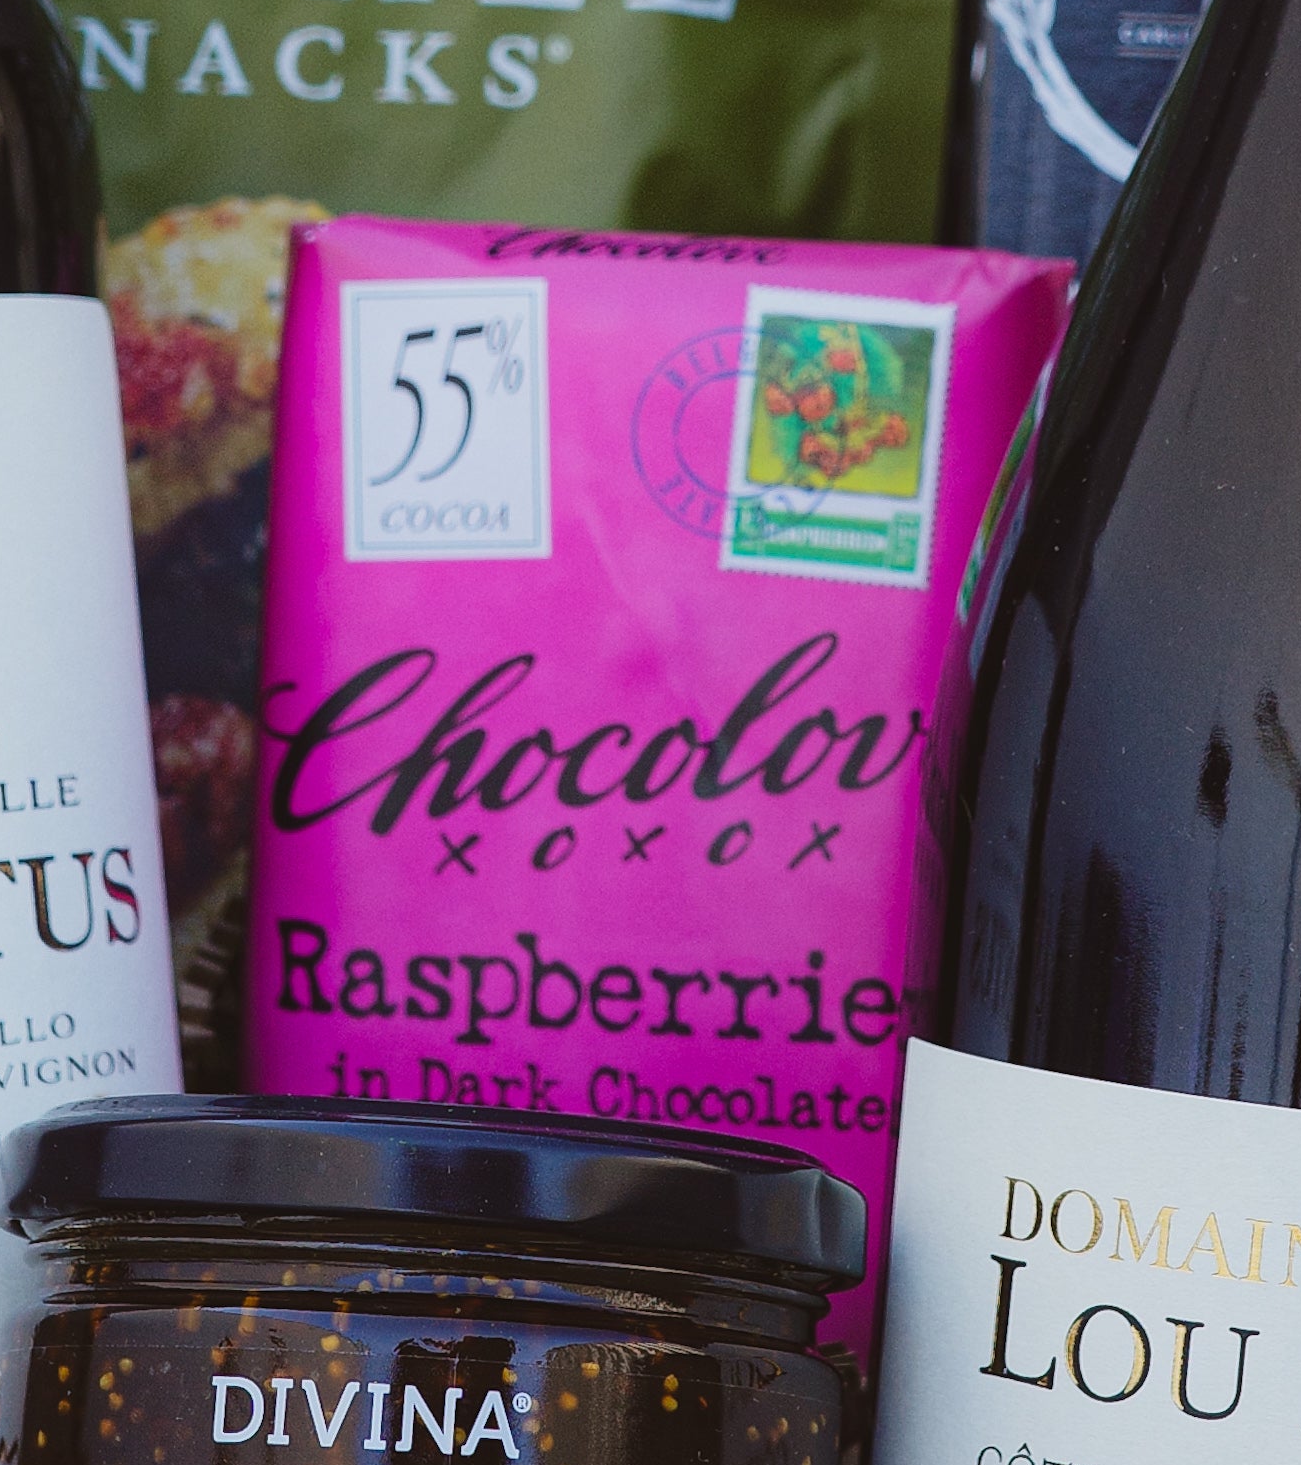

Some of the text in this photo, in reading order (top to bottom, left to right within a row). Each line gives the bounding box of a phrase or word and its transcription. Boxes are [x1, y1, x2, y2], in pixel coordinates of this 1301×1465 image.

[379, 502, 511, 533] COCOA
[262, 632, 929, 836] Chocolov
[277, 917, 901, 1045] Raspberrie
[421, 1059, 562, 1114] Dark
[589, 1066, 888, 1132] Chocolate
[979, 1254, 1259, 1421] LOU
